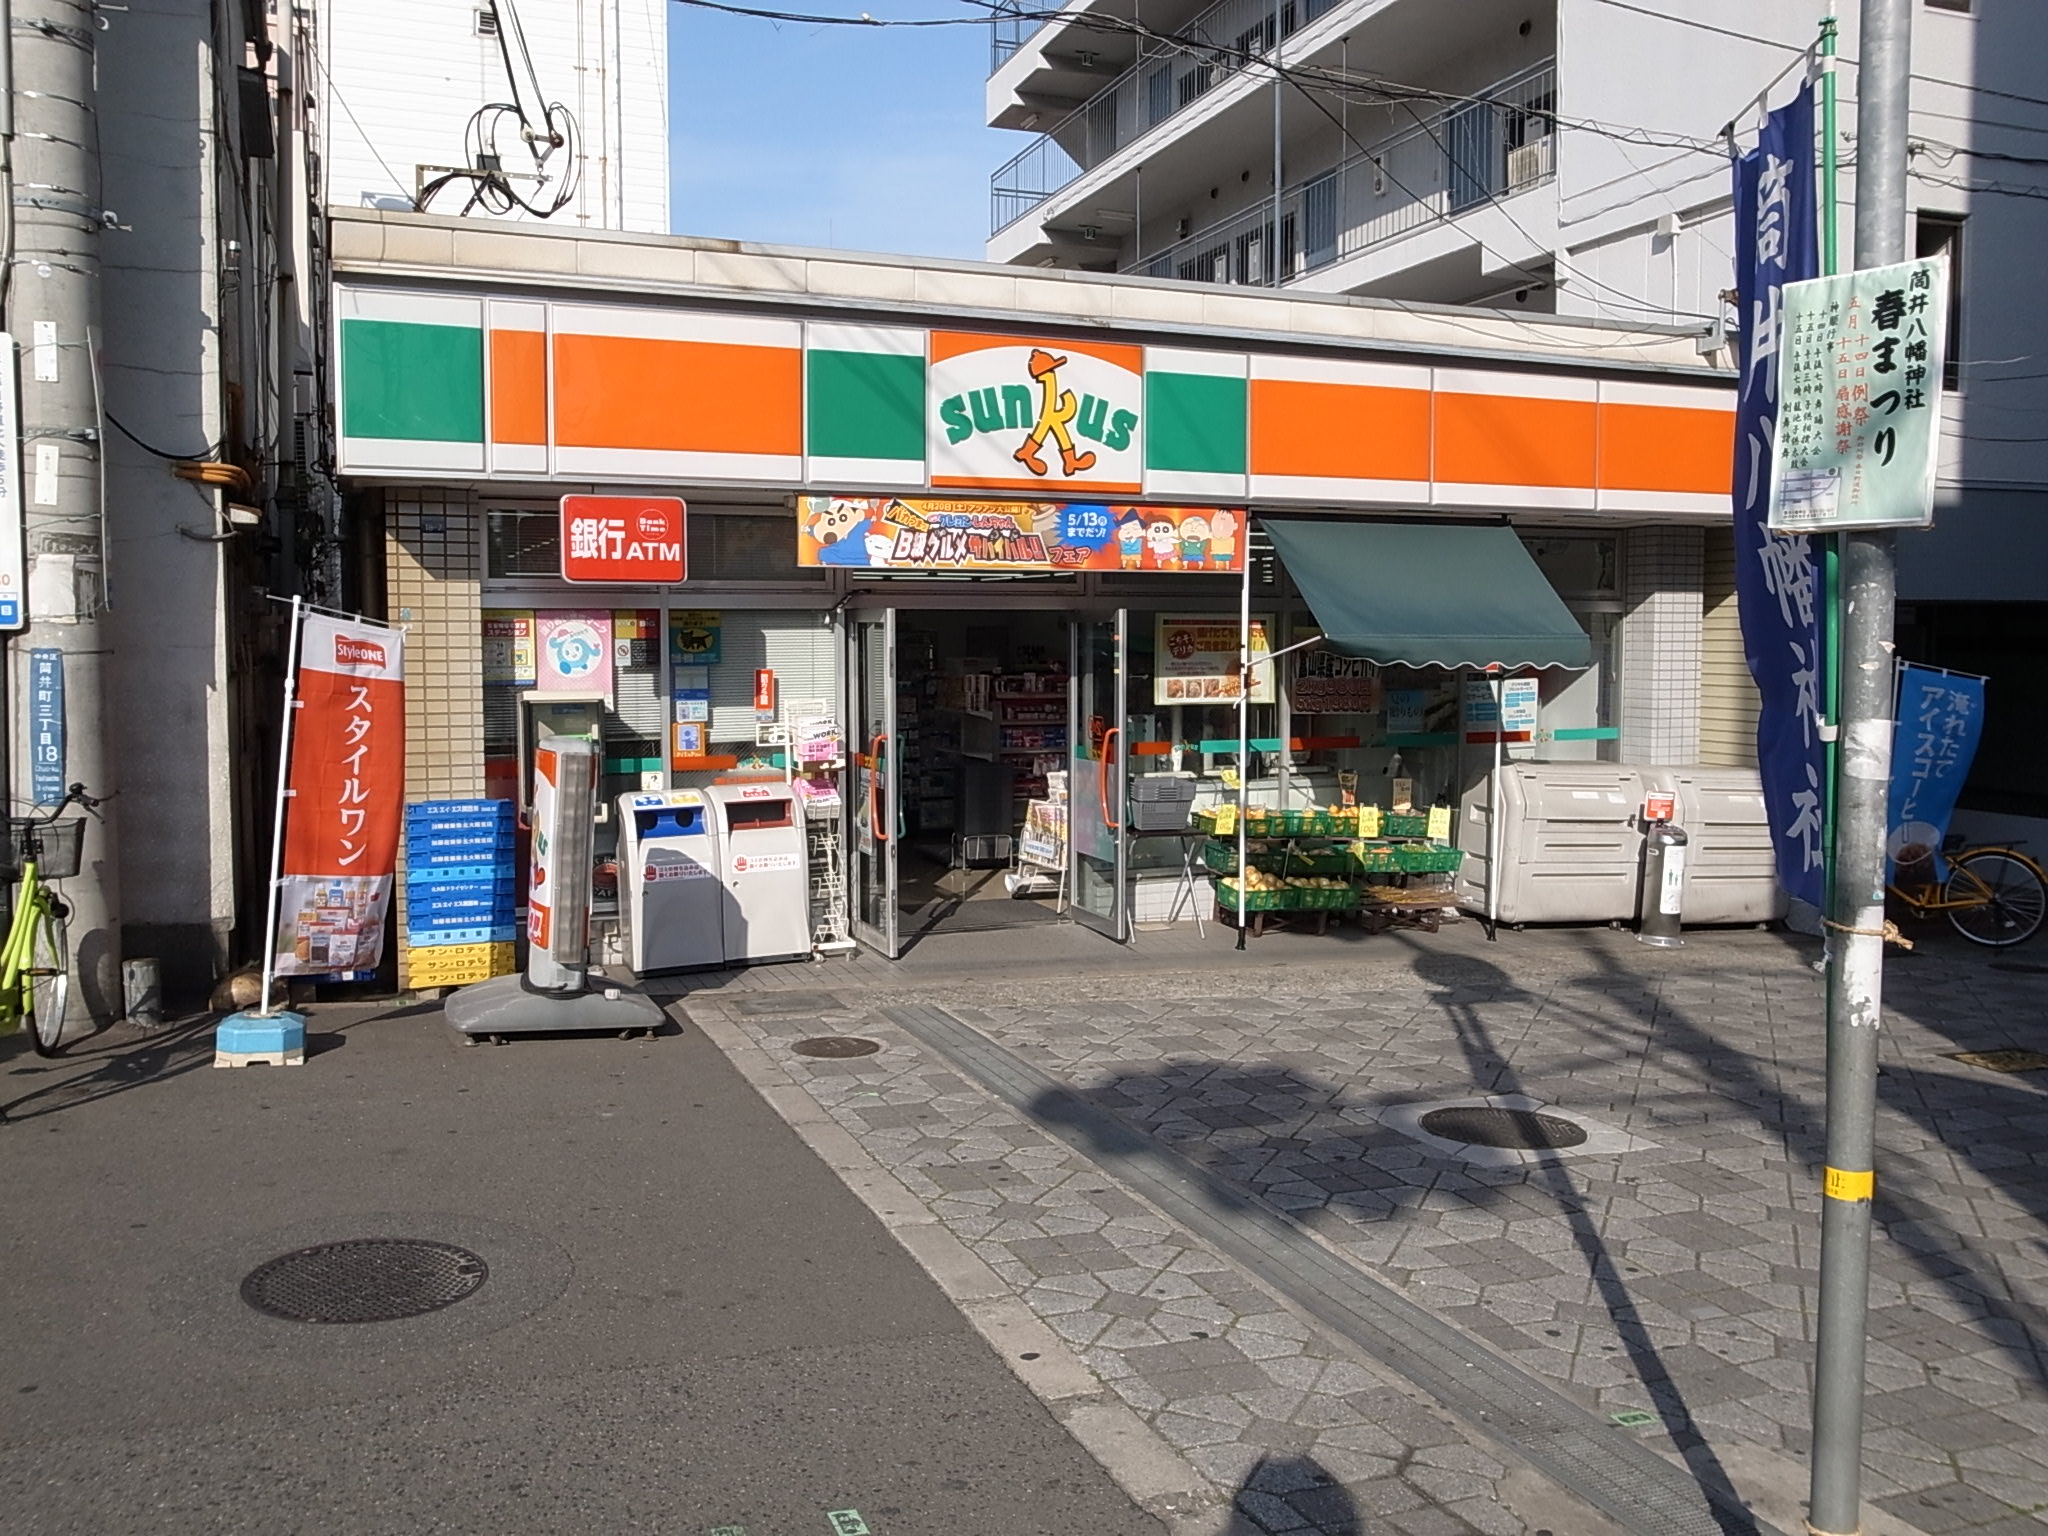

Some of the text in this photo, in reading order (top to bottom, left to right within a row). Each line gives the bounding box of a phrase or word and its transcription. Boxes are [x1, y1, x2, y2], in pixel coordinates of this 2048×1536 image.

[1848, 295, 1861, 330] 五月
[1836, 337, 1852, 380] 十五日
[1854, 334, 1870, 378] 十四日
[1904, 268, 1930, 410] 筒井八幡神社
[1870, 289, 1908, 466] 春まつり
[571, 518, 626, 559] 銀行
[639, 517, 665, 525] Bank
[625, 541, 680, 561] ATM
[1050, 546, 1091, 564] フェア
[337, 643, 384, 664] StyleONE
[38, 662, 52, 745] 筒井町三丁目
[38, 746, 58, 762] 18
[1901, 685, 1945, 845] アイスコーヒー
[338, 685, 373, 867] スタイルワン
